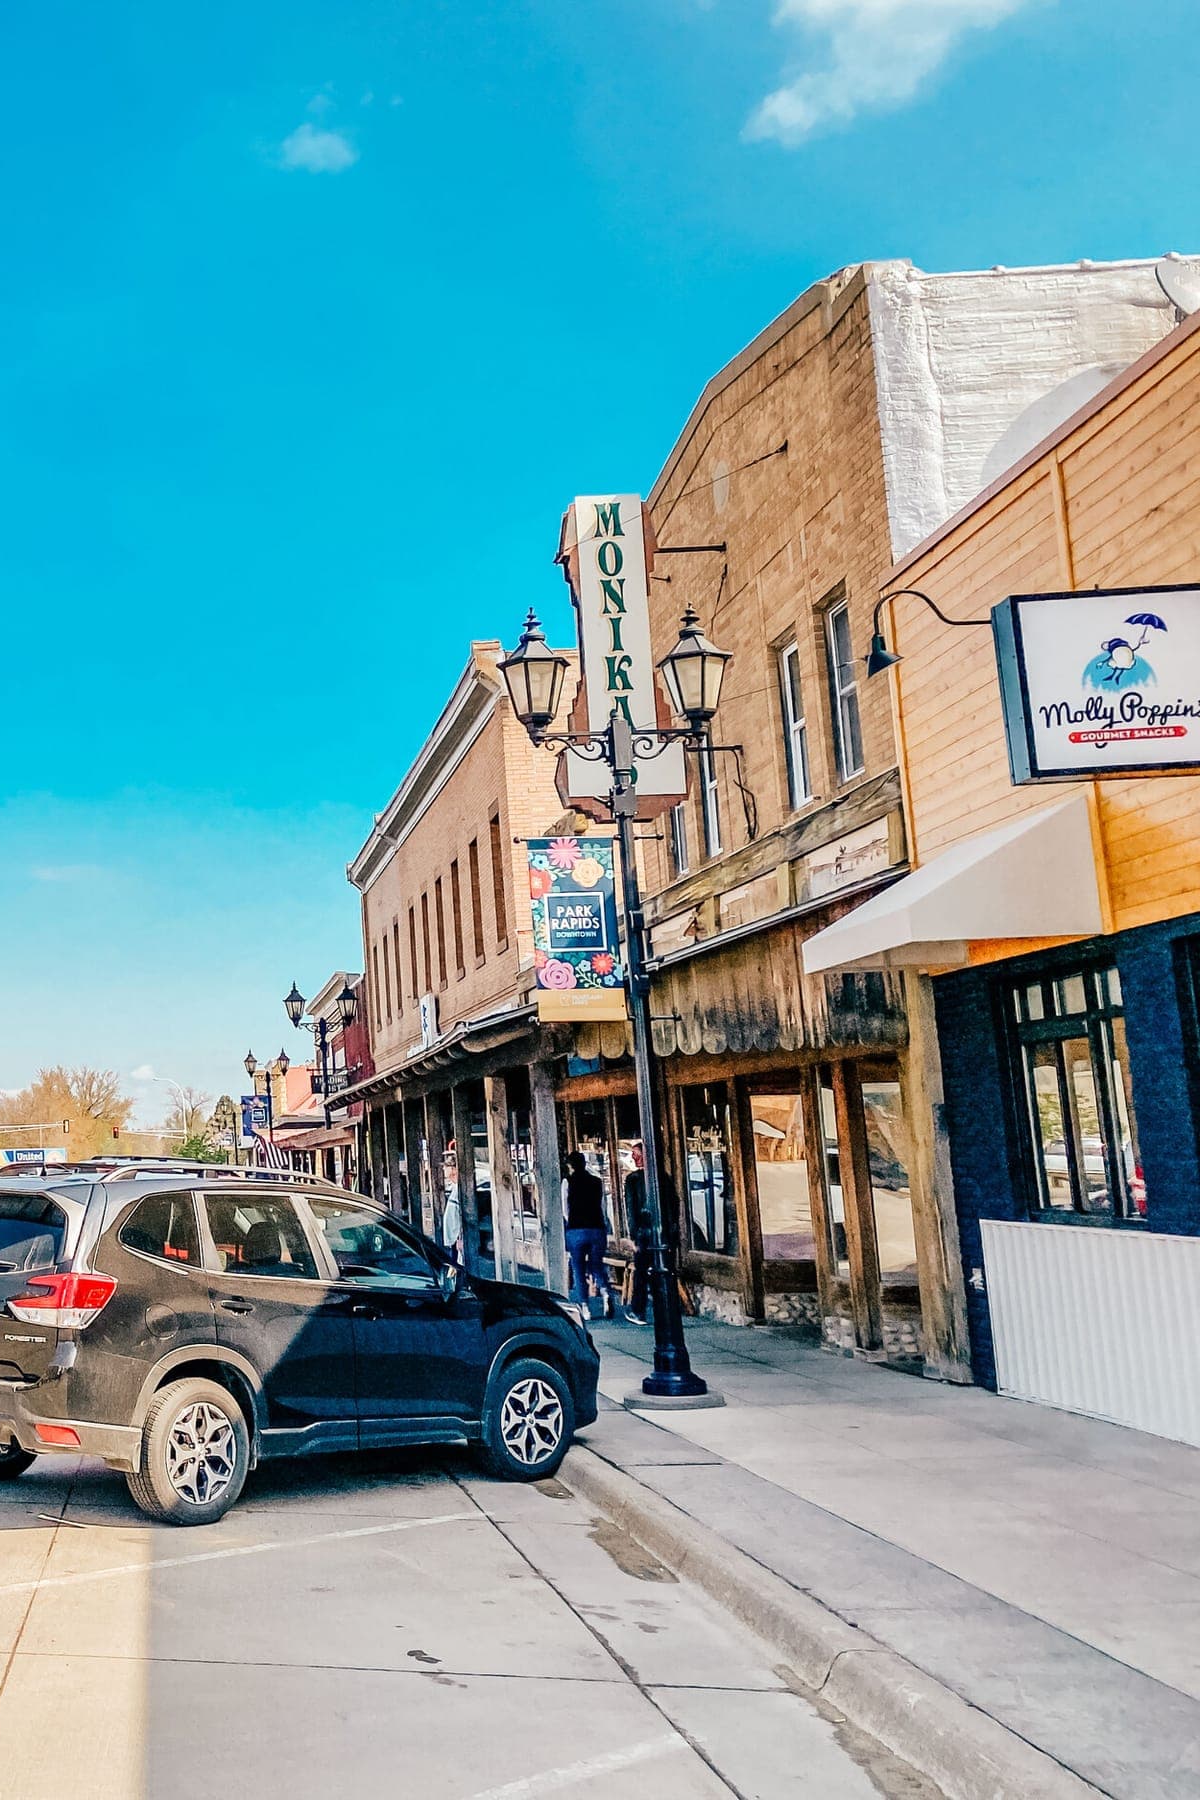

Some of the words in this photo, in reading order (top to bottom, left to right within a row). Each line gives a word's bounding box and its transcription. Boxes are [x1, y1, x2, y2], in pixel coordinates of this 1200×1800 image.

[1039, 696, 1121, 748] Molly
[1080, 731, 1131, 742] GOURMET
[1134, 727, 1175, 738] SNACKS
[556, 905, 594, 918] PARK
[551, 917, 600, 930] RAPIDS
[17, 1151, 44, 1161] United
[4, 1333, 48, 1343] FORESTER
